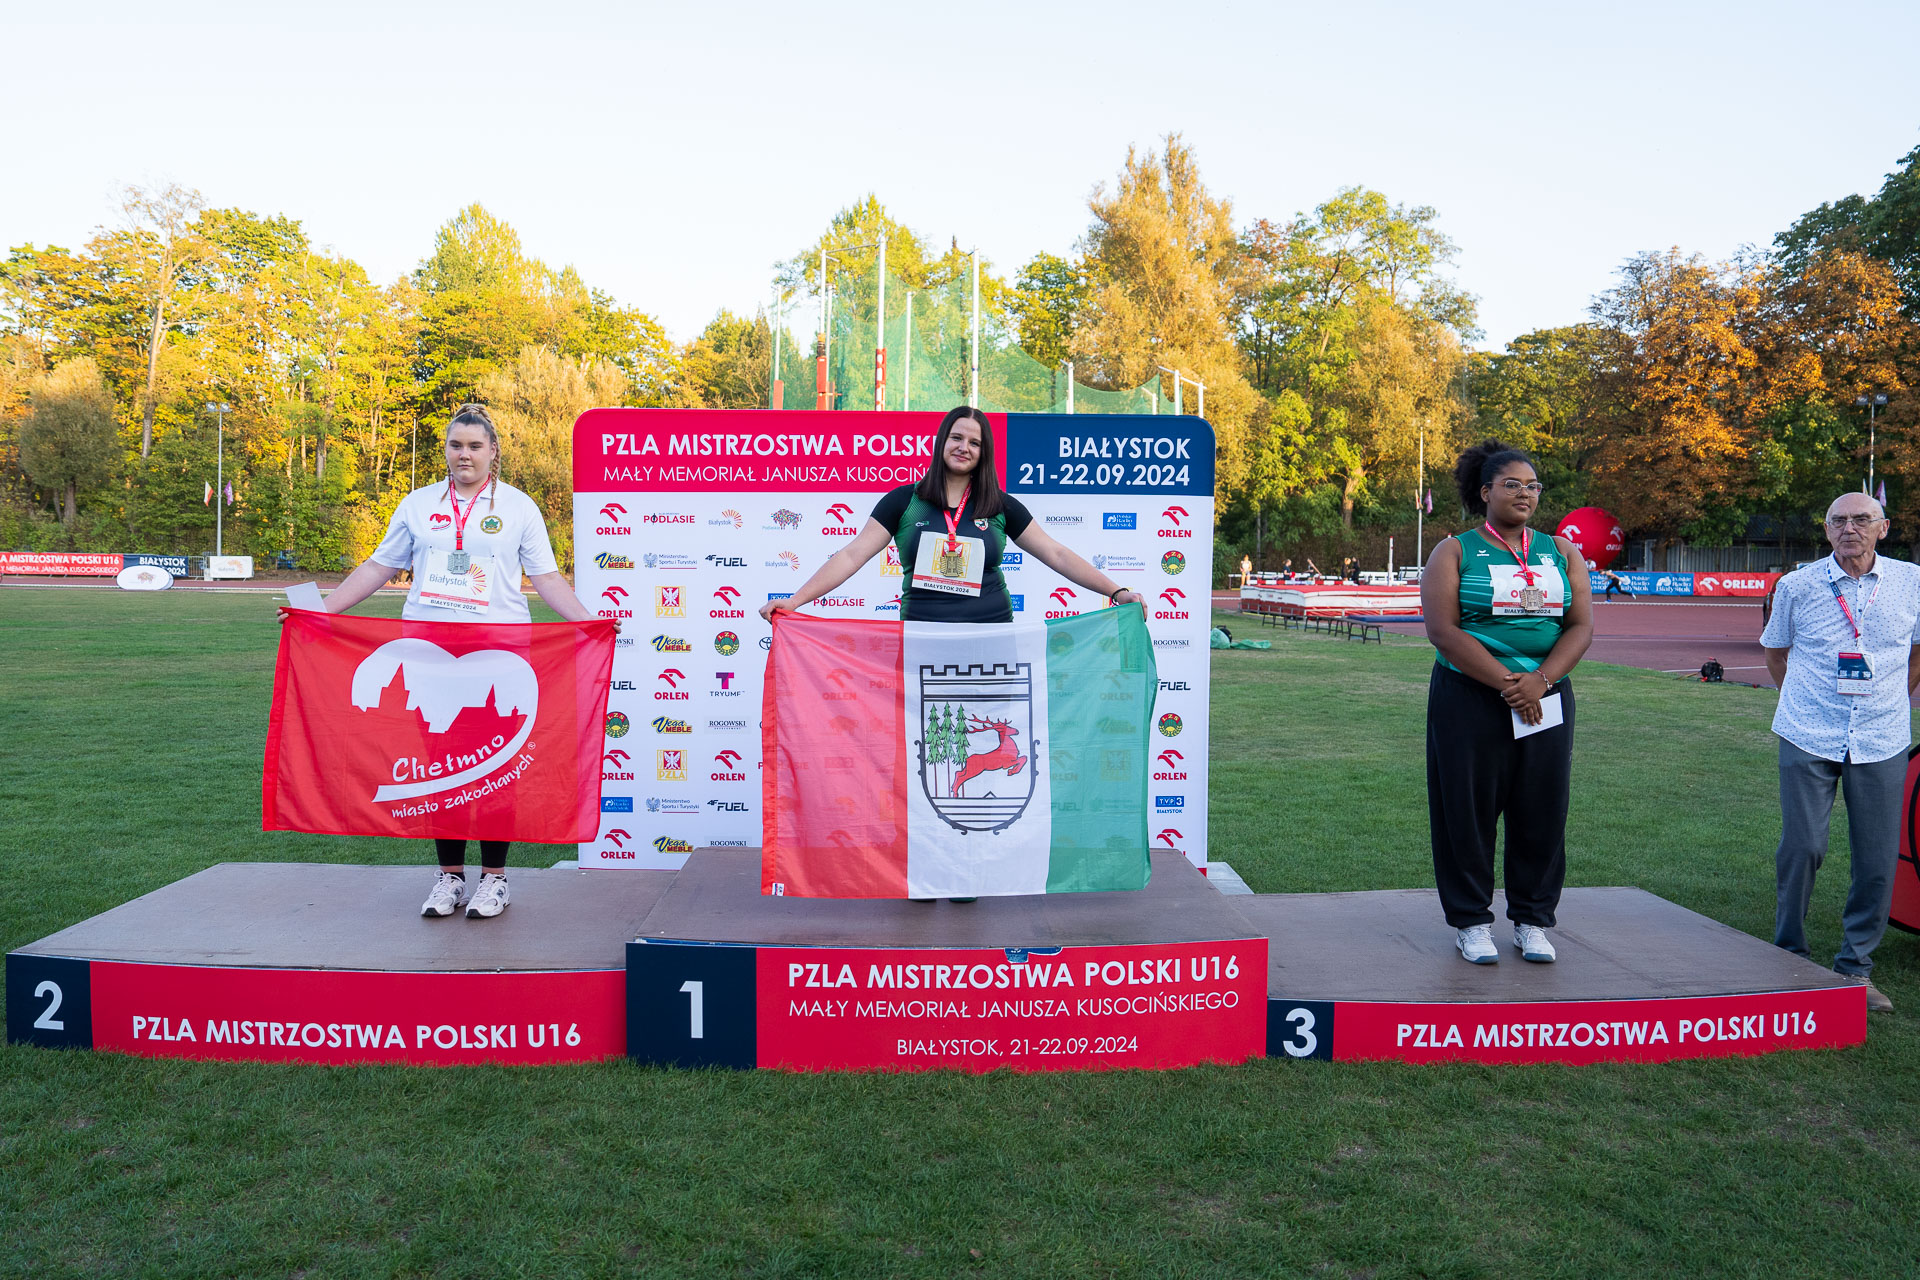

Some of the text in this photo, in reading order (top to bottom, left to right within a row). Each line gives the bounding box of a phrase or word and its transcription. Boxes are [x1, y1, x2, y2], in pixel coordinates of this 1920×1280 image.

[602, 434, 660, 455] PZLA
[669, 434, 844, 456] MISTRZOSTWA
[1059, 436, 1191, 459] BIAŁYSTOK
[604, 464, 929, 483] MAŁY MEMORIAŁ JANUSZA KUSOCIŃ
[1019, 462, 1191, 486] 21-22.09.2024
[643, 514, 696, 524] PODLASIE
[596, 527, 632, 536] ORLEN
[822, 528, 857, 536] ORLEN
[1158, 530, 1192, 538] ORLEN
[10, 555, 69, 564] MISTRZOSTWA
[72, 556, 101, 564] POLSKI
[140, 557, 186, 566] BIAŁYSTOK
[594, 552, 628, 568] Vega
[716, 558, 748, 566] FUEL
[429, 573, 468, 587] Białystok
[1722, 580, 1764, 589] ORLEN
[924, 582, 955, 592] BIAŁYSTOK
[431, 600, 462, 608] BIAŁYSTOK
[813, 599, 864, 607] PODLASIE
[598, 610, 632, 618] ORLEN
[658, 608, 684, 617] PZLA
[710, 610, 744, 618] ORLEN
[1155, 611, 1189, 619] ORLEN
[651, 634, 685, 651] Vega
[1160, 682, 1191, 690] FUEL
[652, 716, 686, 734] Vega
[392, 734, 504, 782] Chełmno
[601, 772, 634, 780] ORLEN
[1153, 772, 1187, 780] ORLEN
[392, 752, 534, 818] miasto zakochanych
[717, 802, 749, 811] FUEL
[1176, 797, 1183, 806] 3
[652, 836, 686, 853] Vega
[601, 852, 636, 860] ORLEN
[788, 955, 1240, 989] PZLA MISTRZOSTWA POLSKI U16
[33, 980, 64, 1030] 2
[789, 990, 1239, 1018] MAŁY MEMORIAŁ JANUSZA KUSOCIŃSKIEGO
[679, 981, 704, 1039] 1
[132, 1016, 581, 1049] PZLA MISTRZOSTWA POLSKI U16
[1283, 1008, 1317, 1058] 3
[1397, 1010, 1817, 1048] PZLA MISTRZOSTWA POLSKI U16
[896, 1036, 1138, 1056] BIAŁYSTOK, 21-22.09.2024
